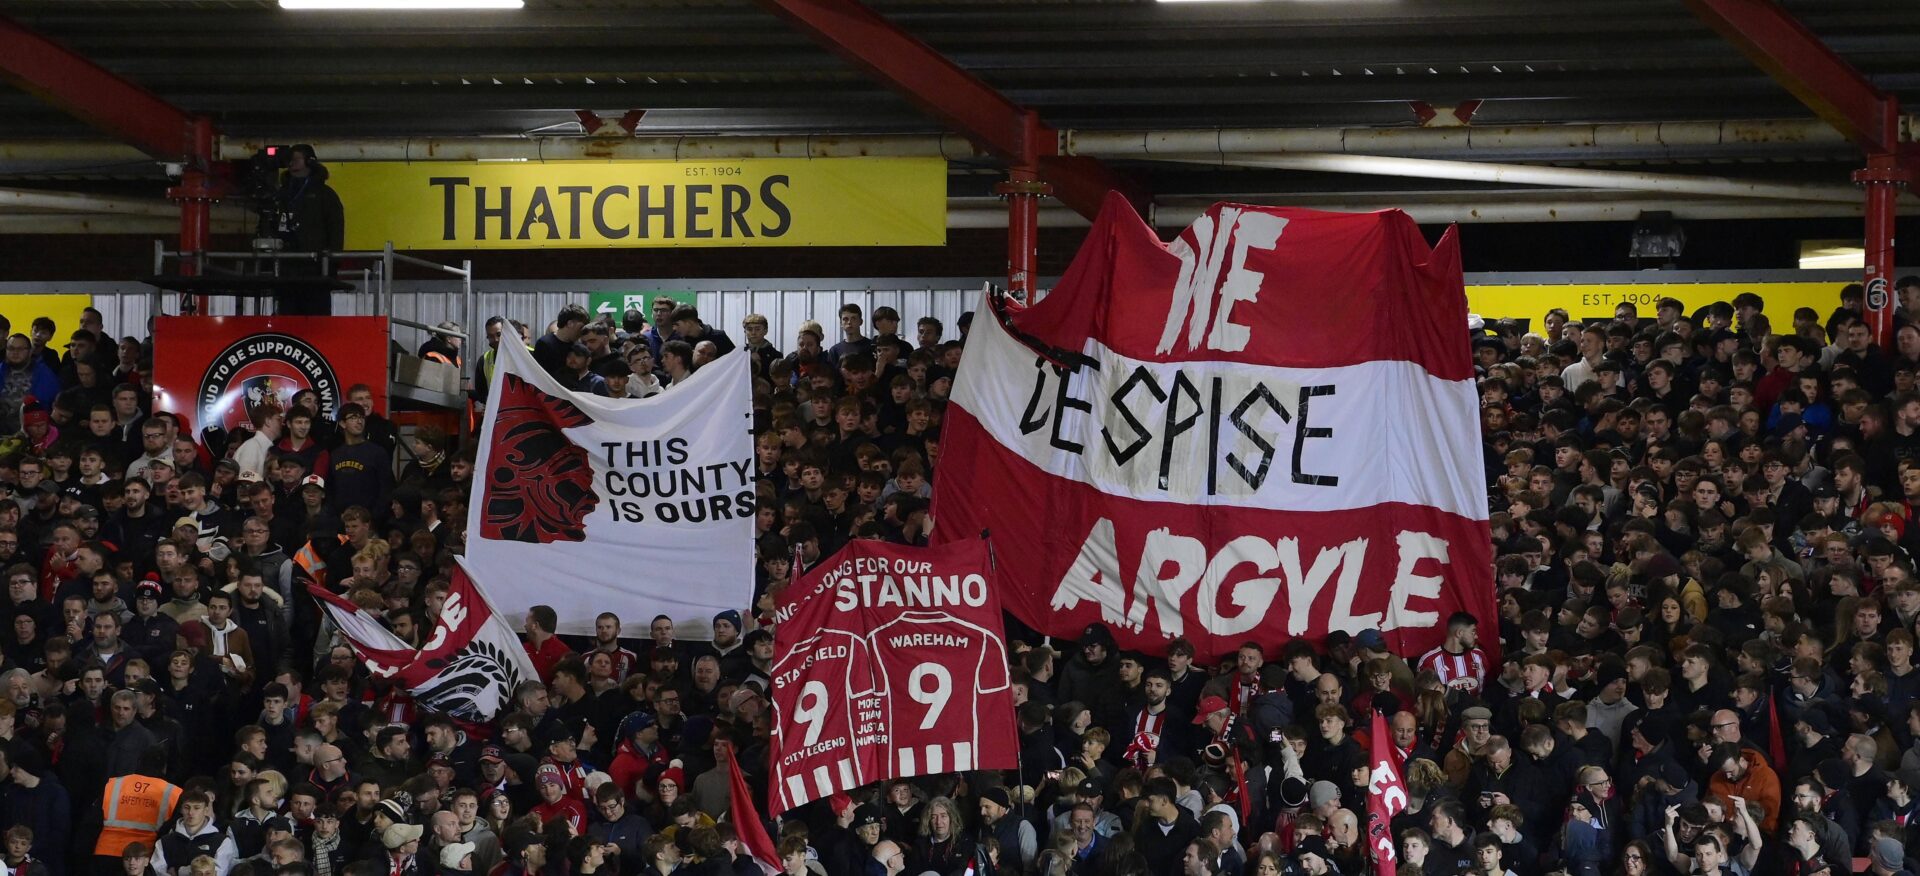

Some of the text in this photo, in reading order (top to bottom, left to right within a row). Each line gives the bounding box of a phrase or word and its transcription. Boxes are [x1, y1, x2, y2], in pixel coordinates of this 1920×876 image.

[685, 167, 742, 177] EST. 1904
[429, 175, 791, 240] THATCHERS
[1154, 206, 1290, 356] WE
[1866, 278, 1888, 311] 6
[1582, 294, 1661, 306] EST. 1904
[213, 364, 229, 381] TO
[228, 349, 247, 366] BE
[248, 341, 323, 379] SUPPORTER
[317, 379, 333, 421] OWNE
[1019, 353, 1338, 496] DESPISE
[601, 437, 688, 467] THIS
[605, 458, 752, 498] COUNTY
[609, 491, 755, 523] IS OURS
[855, 557, 889, 574] FOR
[894, 558, 932, 574] OUR
[1050, 516, 1451, 639] ARGYLE
[834, 573, 987, 612] STANNO
[889, 634, 968, 648] WAREHAM
[908, 662, 952, 730] 9
[793, 680, 828, 747] 9
[877, 722, 885, 732] A
[784, 737, 846, 766] CITY LEGEND
[133, 781, 151, 794] 97
